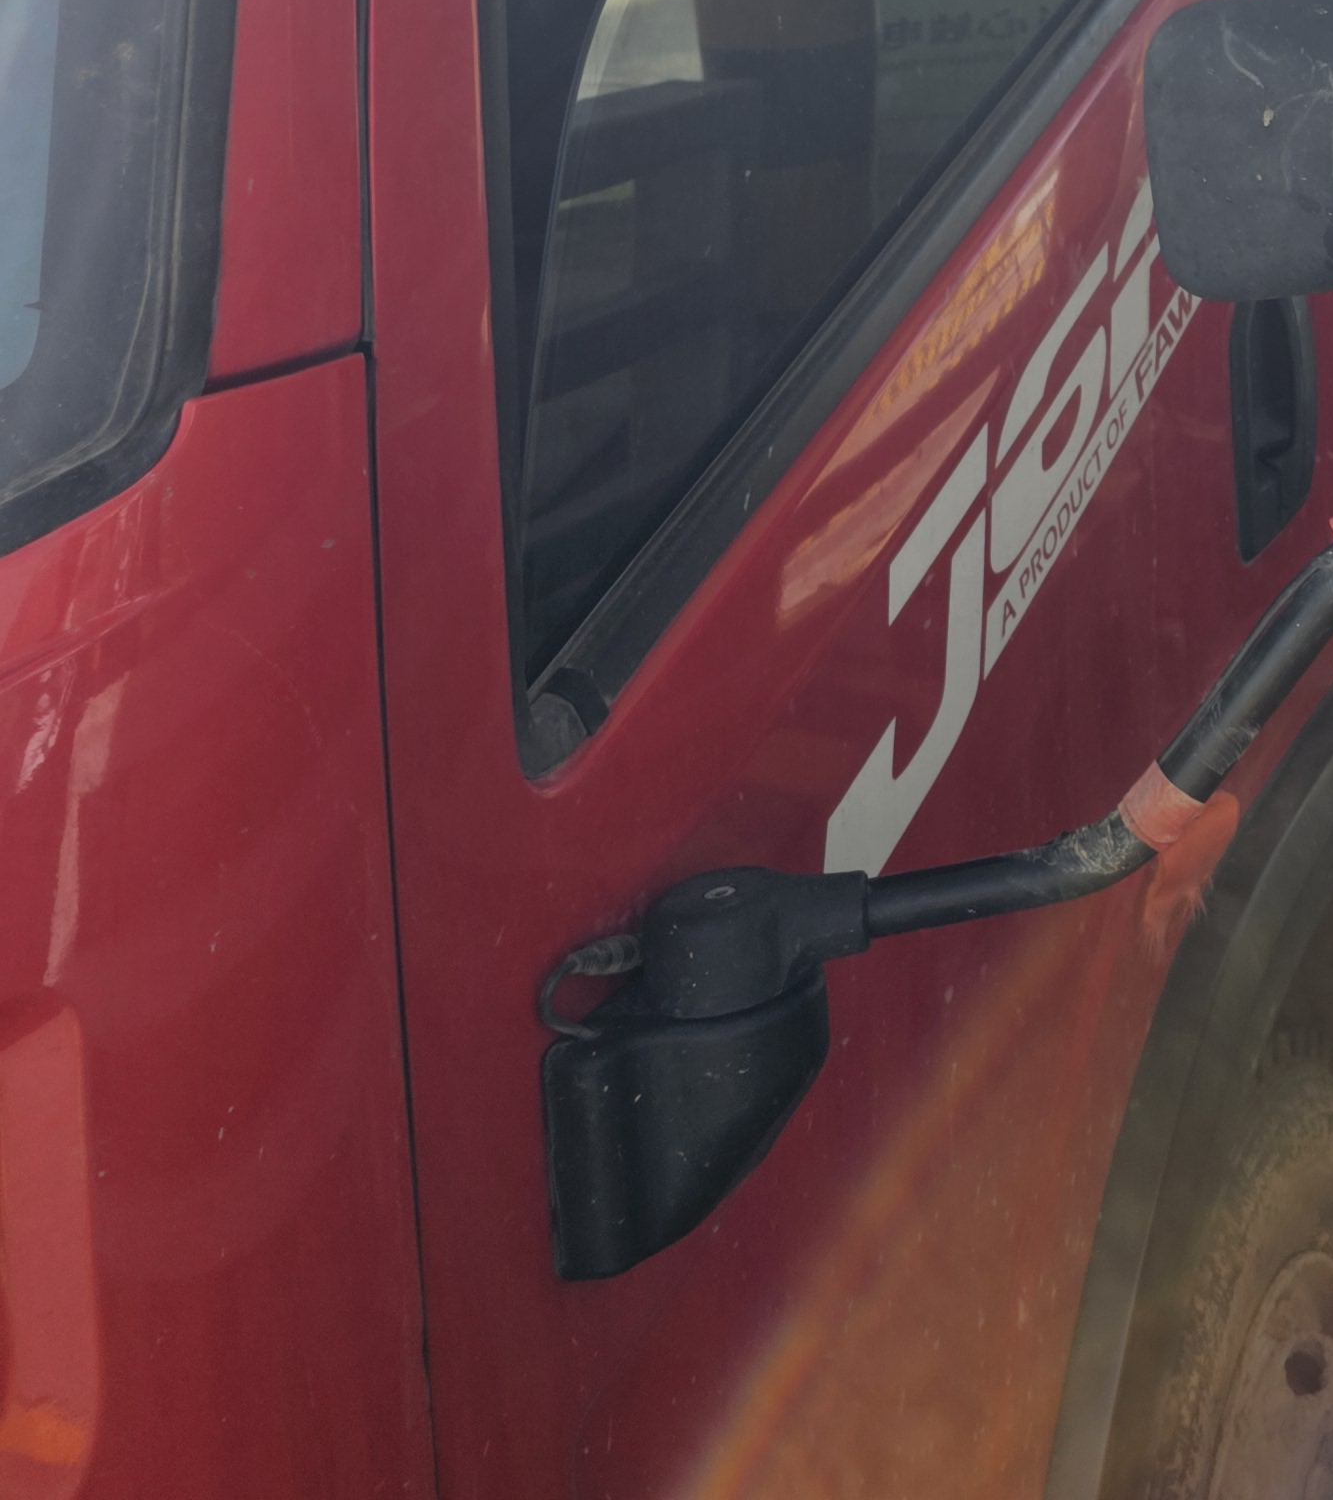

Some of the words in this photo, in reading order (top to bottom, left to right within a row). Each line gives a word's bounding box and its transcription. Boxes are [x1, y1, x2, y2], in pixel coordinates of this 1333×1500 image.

[1001, 598, 1016, 637] A
[1018, 445, 1103, 599] PRODUCT
[1105, 397, 1128, 451] OF
[1134, 290, 1193, 404] FAW
